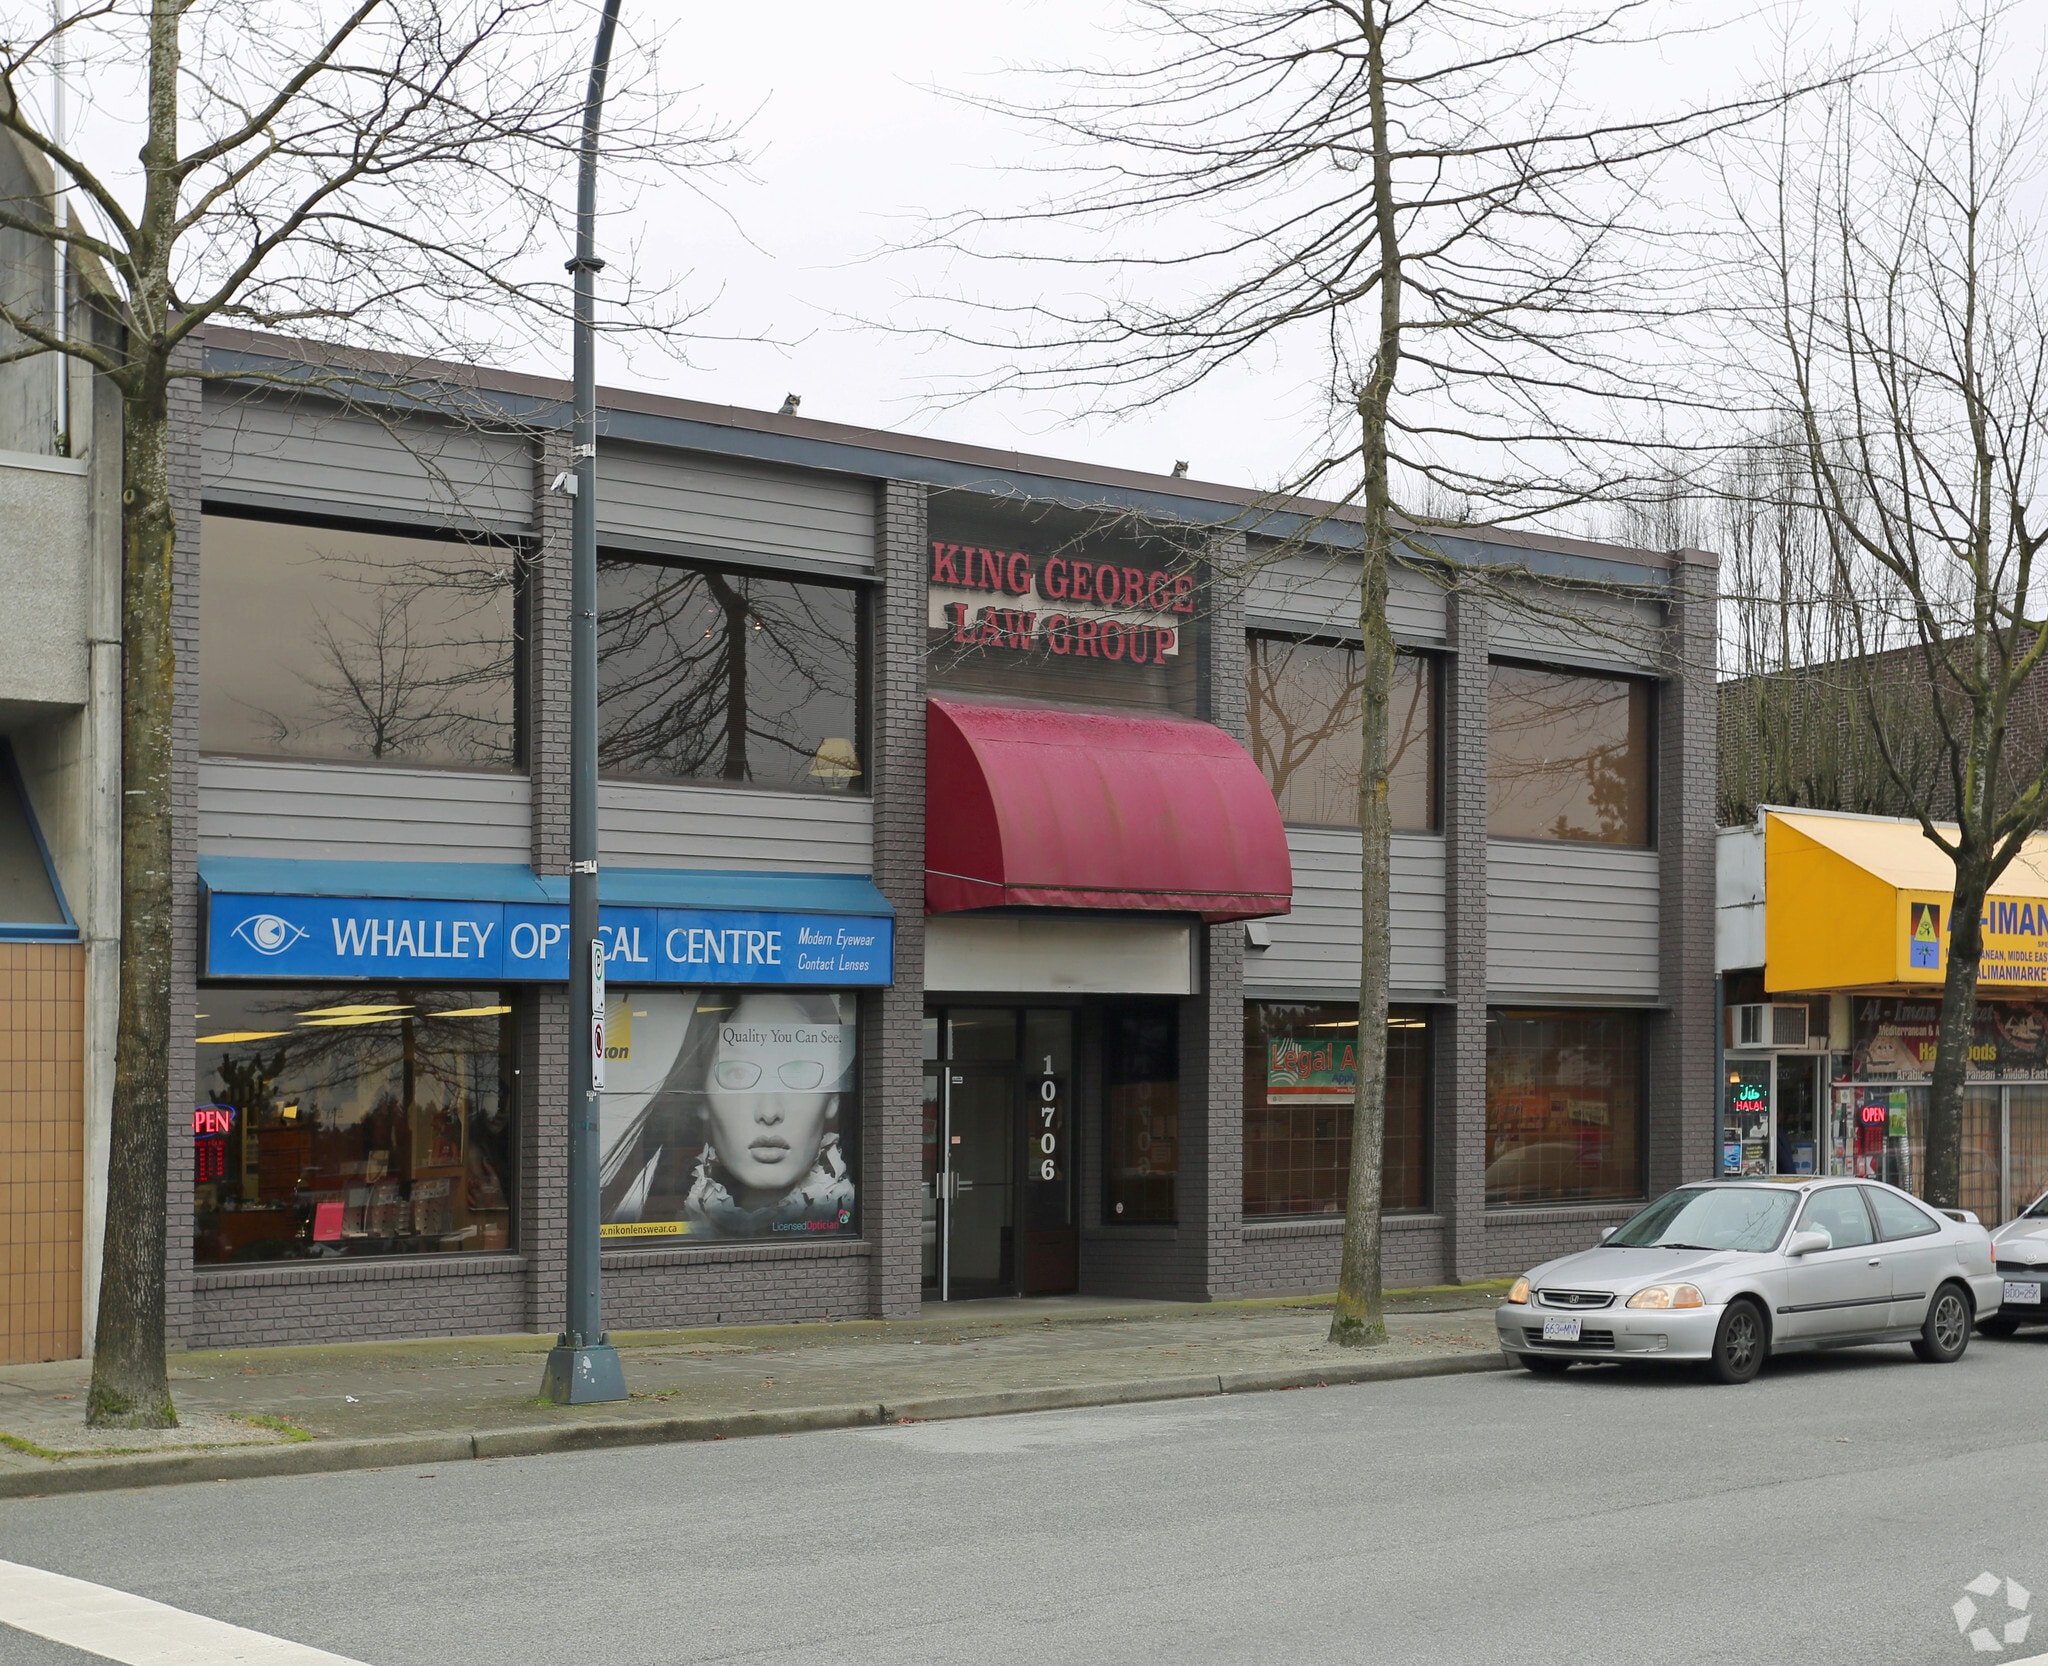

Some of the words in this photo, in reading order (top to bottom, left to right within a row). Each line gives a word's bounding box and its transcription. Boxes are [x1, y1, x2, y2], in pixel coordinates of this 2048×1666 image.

[932, 541, 1034, 594] KING
[1044, 557, 1194, 613] GEORGE
[953, 602, 1036, 650] LAW
[1049, 614, 1175, 664] GROUP
[331, 918, 496, 958] WHALLEY
[510, 922, 649, 963] OPCAL
[666, 928, 782, 965] CENTRE
[798, 927, 832, 946] Modern
[837, 928, 875, 950] Eyewear
[798, 953, 834, 971] Contact
[839, 954, 870, 972] Lenses
[2008, 951, 2033, 962] MIDDLE
[2035, 952, 2048, 962] EAS
[723, 1027, 768, 1047] Quality
[770, 1029, 792, 1043] You
[795, 1029, 818, 1043] Can
[821, 1029, 842, 1043] See.
[1272, 1042, 1333, 1079] Legal
[1340, 1044, 1358, 1071] A
[1919, 1043, 1937, 1061] Ha
[1966, 1042, 1997, 1061] oods
[1897, 1069, 1925, 1081] Arabic
[1735, 1101, 1764, 1111] HALAL
[1862, 1107, 1885, 1123] OPEN
[192, 1110, 230, 1133] PEN
[600, 1224, 677, 1236] w.nikonlenswear.ca
